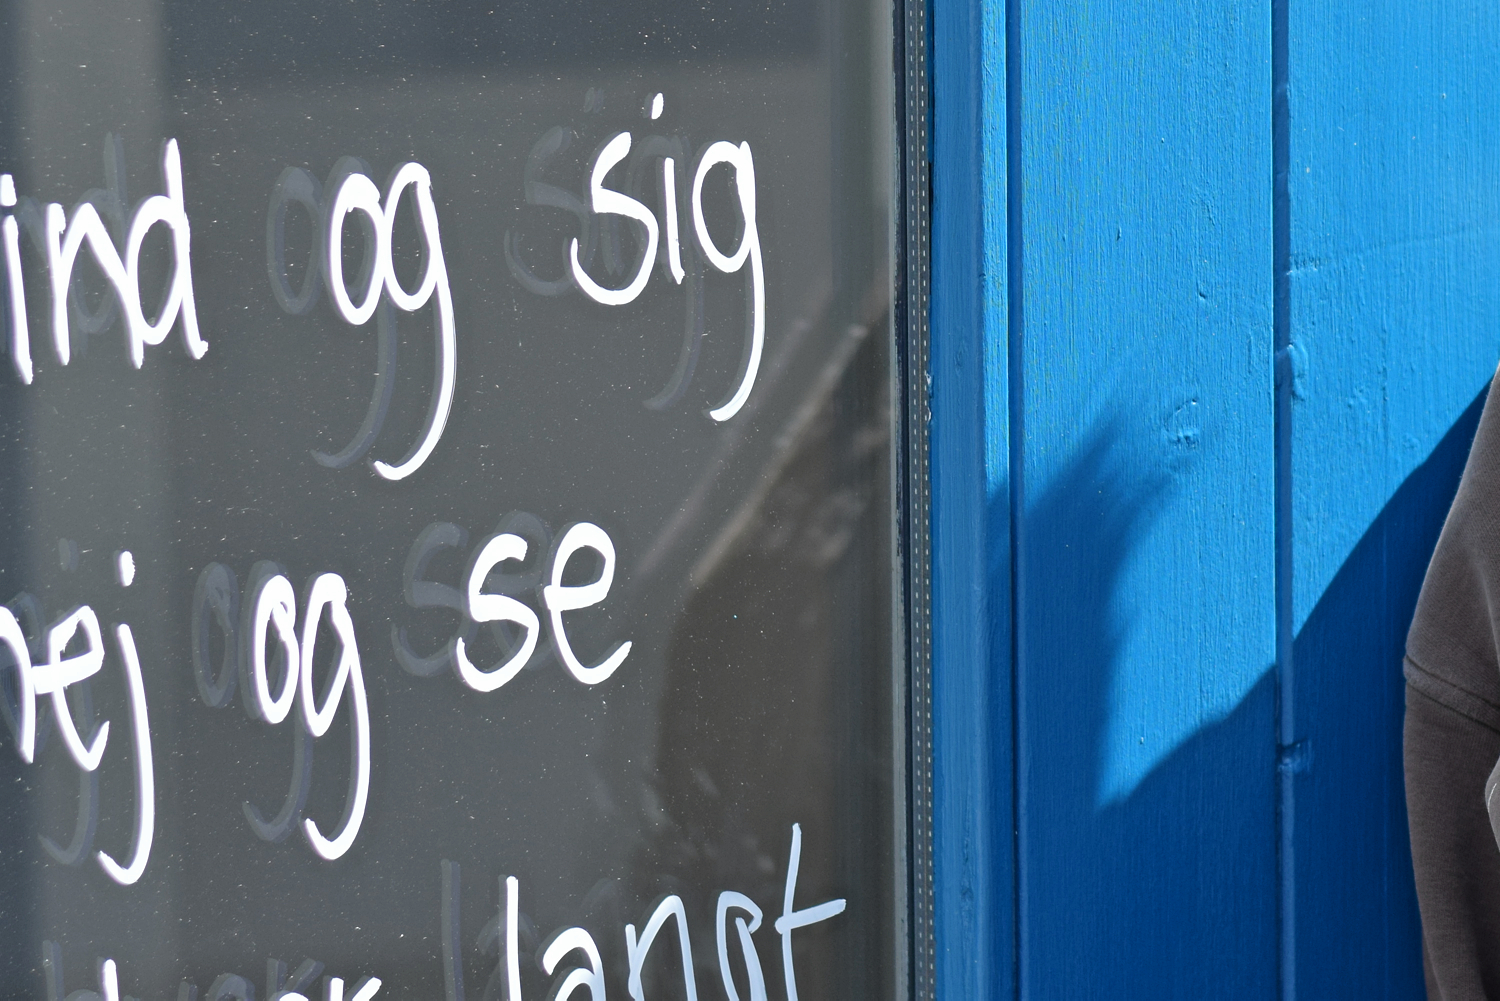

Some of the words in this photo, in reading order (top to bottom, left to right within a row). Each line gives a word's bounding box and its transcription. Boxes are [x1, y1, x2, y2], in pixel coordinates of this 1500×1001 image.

[0, 137, 209, 385] ind
[329, 162, 456, 481] og
[570, 92, 766, 422] sig
[254, 572, 371, 860] og
[456, 522, 633, 693] se
